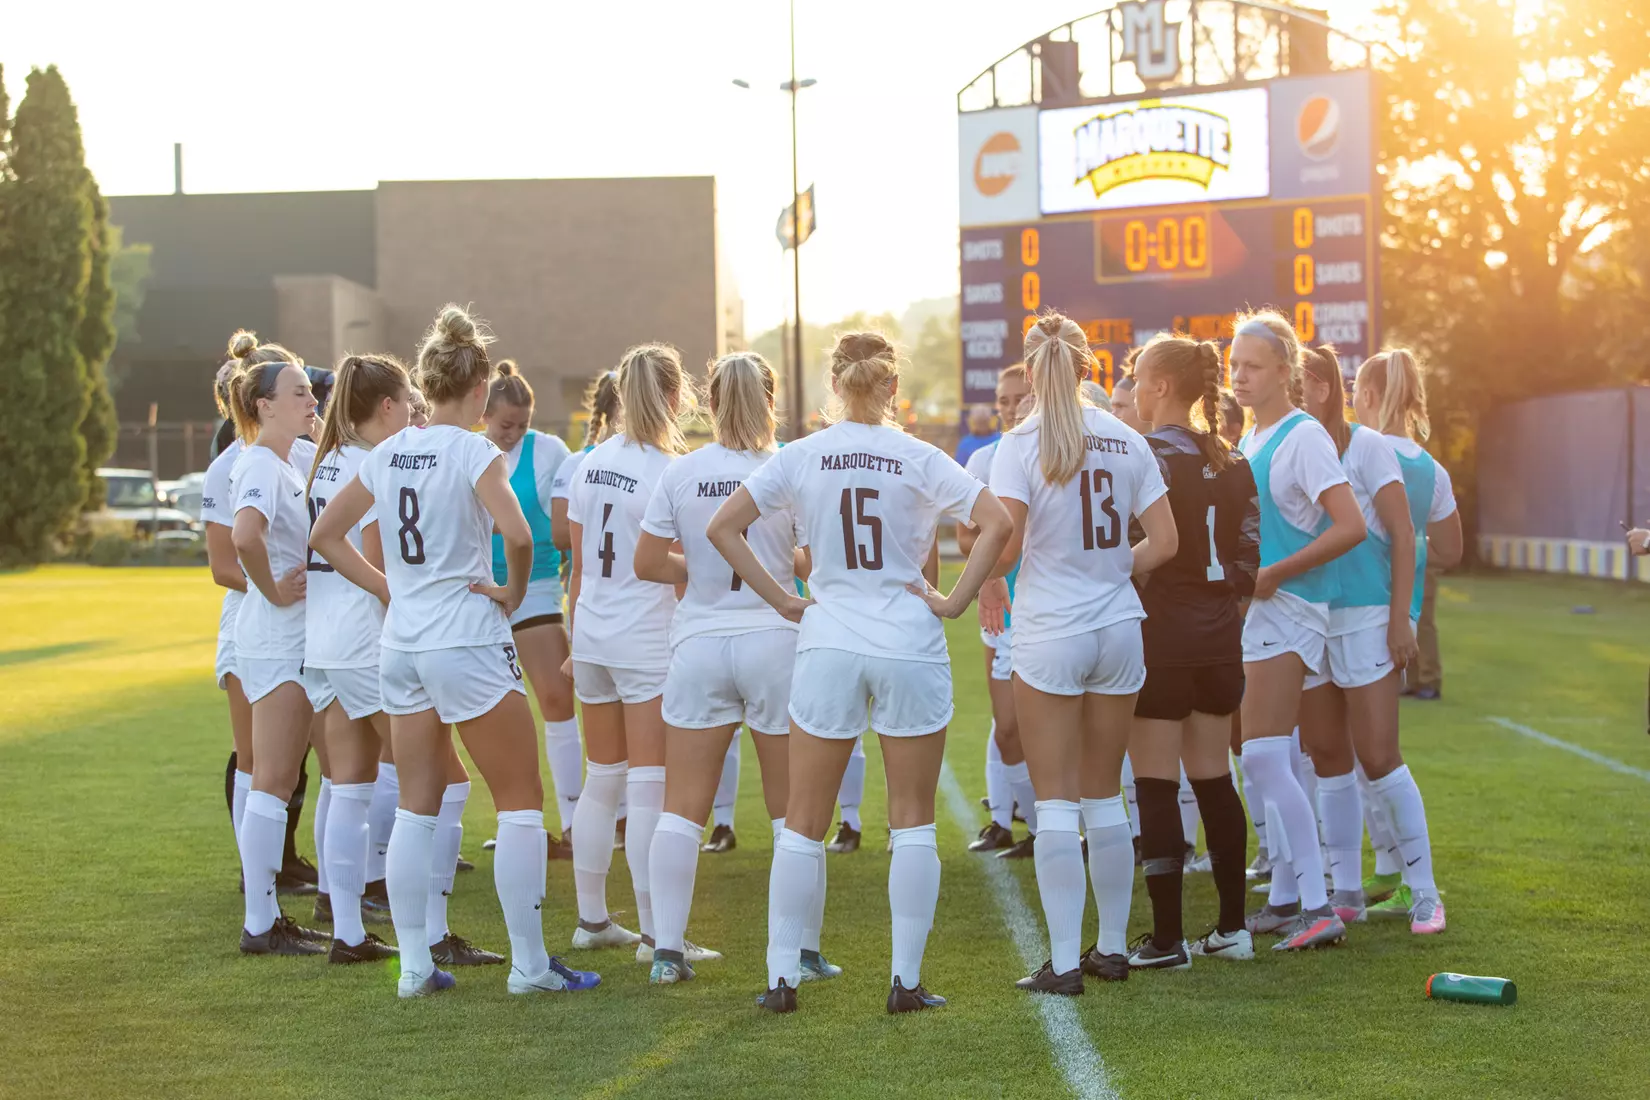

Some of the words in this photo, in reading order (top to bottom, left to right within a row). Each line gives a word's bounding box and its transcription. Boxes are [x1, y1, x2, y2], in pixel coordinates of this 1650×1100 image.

[1122, 1, 1181, 79] MU
[1021, 228, 1039, 266] 0
[1125, 216, 1207, 271] 0:00
[1294, 207, 1313, 248] 0
[1022, 271, 1040, 310] 0
[1294, 254, 1314, 295] 0
[1295, 301, 1315, 342] 0
[821, 452, 903, 475] MARQUETTE
[1086, 435, 1128, 455] QUETTE
[697, 480, 742, 498] MARQU
[1080, 469, 1122, 550] 13
[399, 487, 425, 565] 8
[598, 503, 615, 578] 4
[840, 488, 884, 571] 15
[1206, 505, 1225, 581] 1
